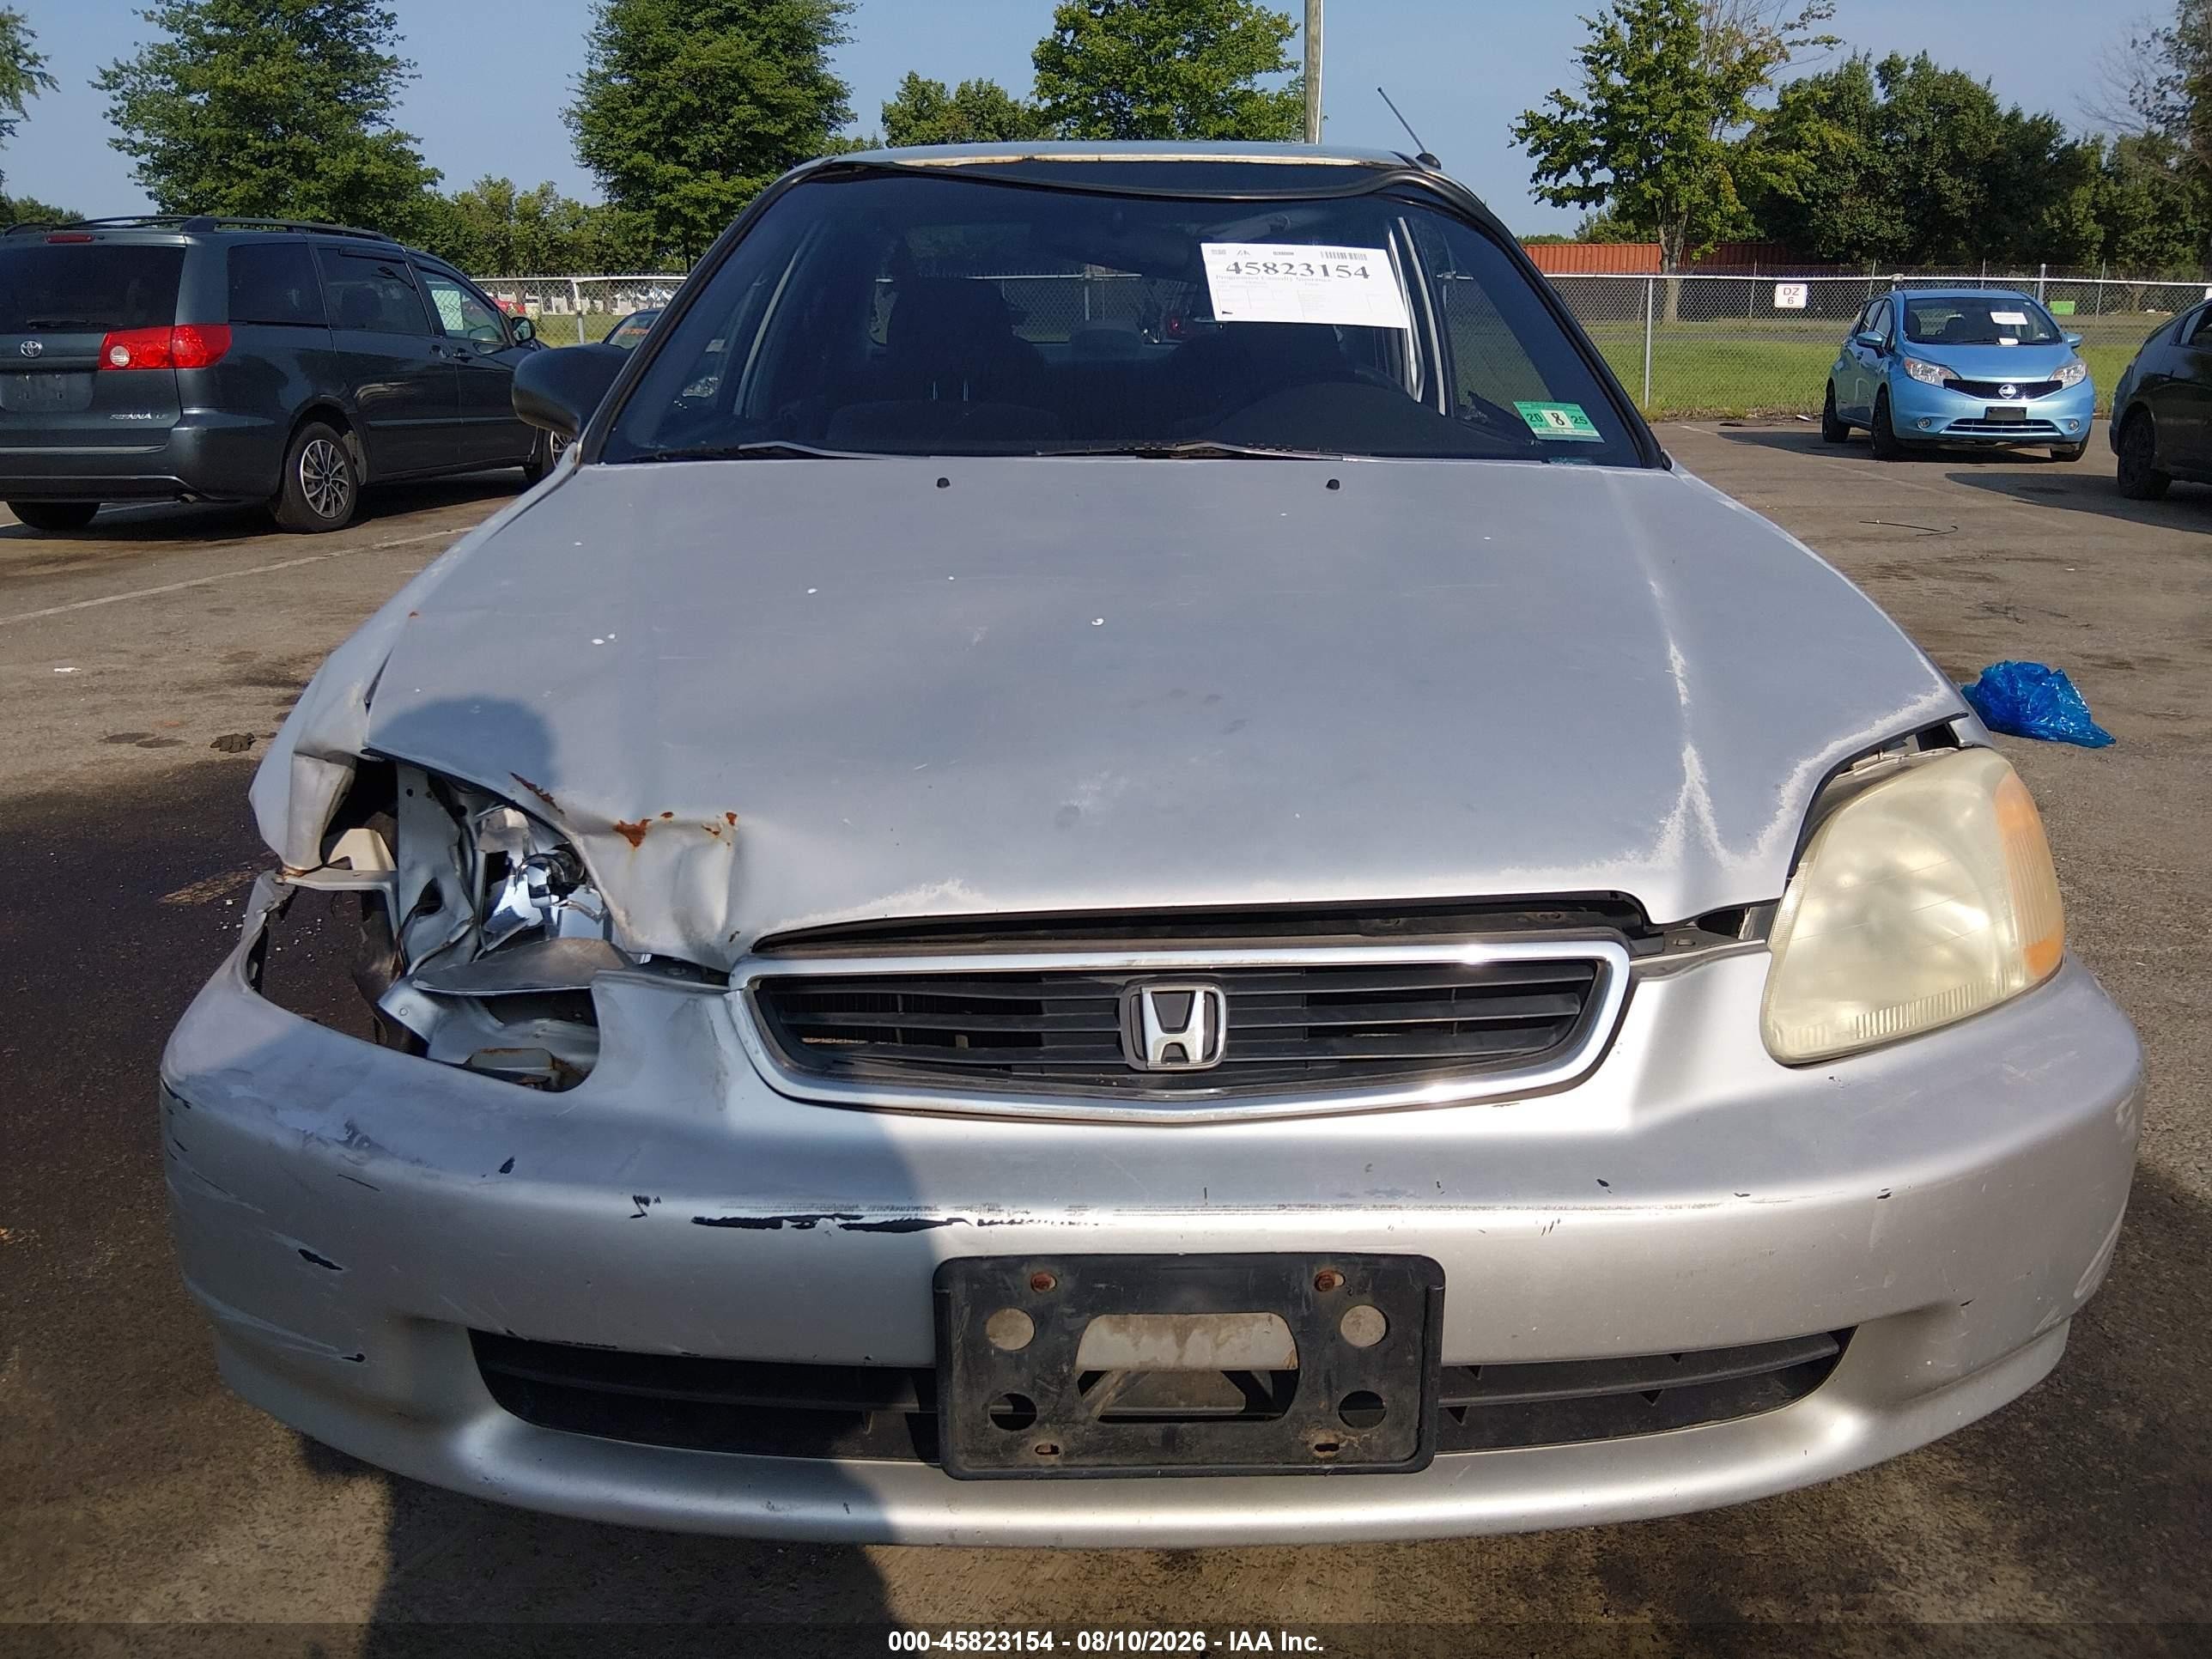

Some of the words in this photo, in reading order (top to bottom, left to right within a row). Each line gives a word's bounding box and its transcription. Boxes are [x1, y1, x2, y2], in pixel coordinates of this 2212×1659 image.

[1226, 261, 1370, 279] 45823154
[1783, 287, 1800, 296] DZ
[1787, 296, 1794, 305] 6
[1526, 413, 1544, 423] 20
[1551, 412, 1565, 426] 8
[1571, 416, 1588, 425] 25
